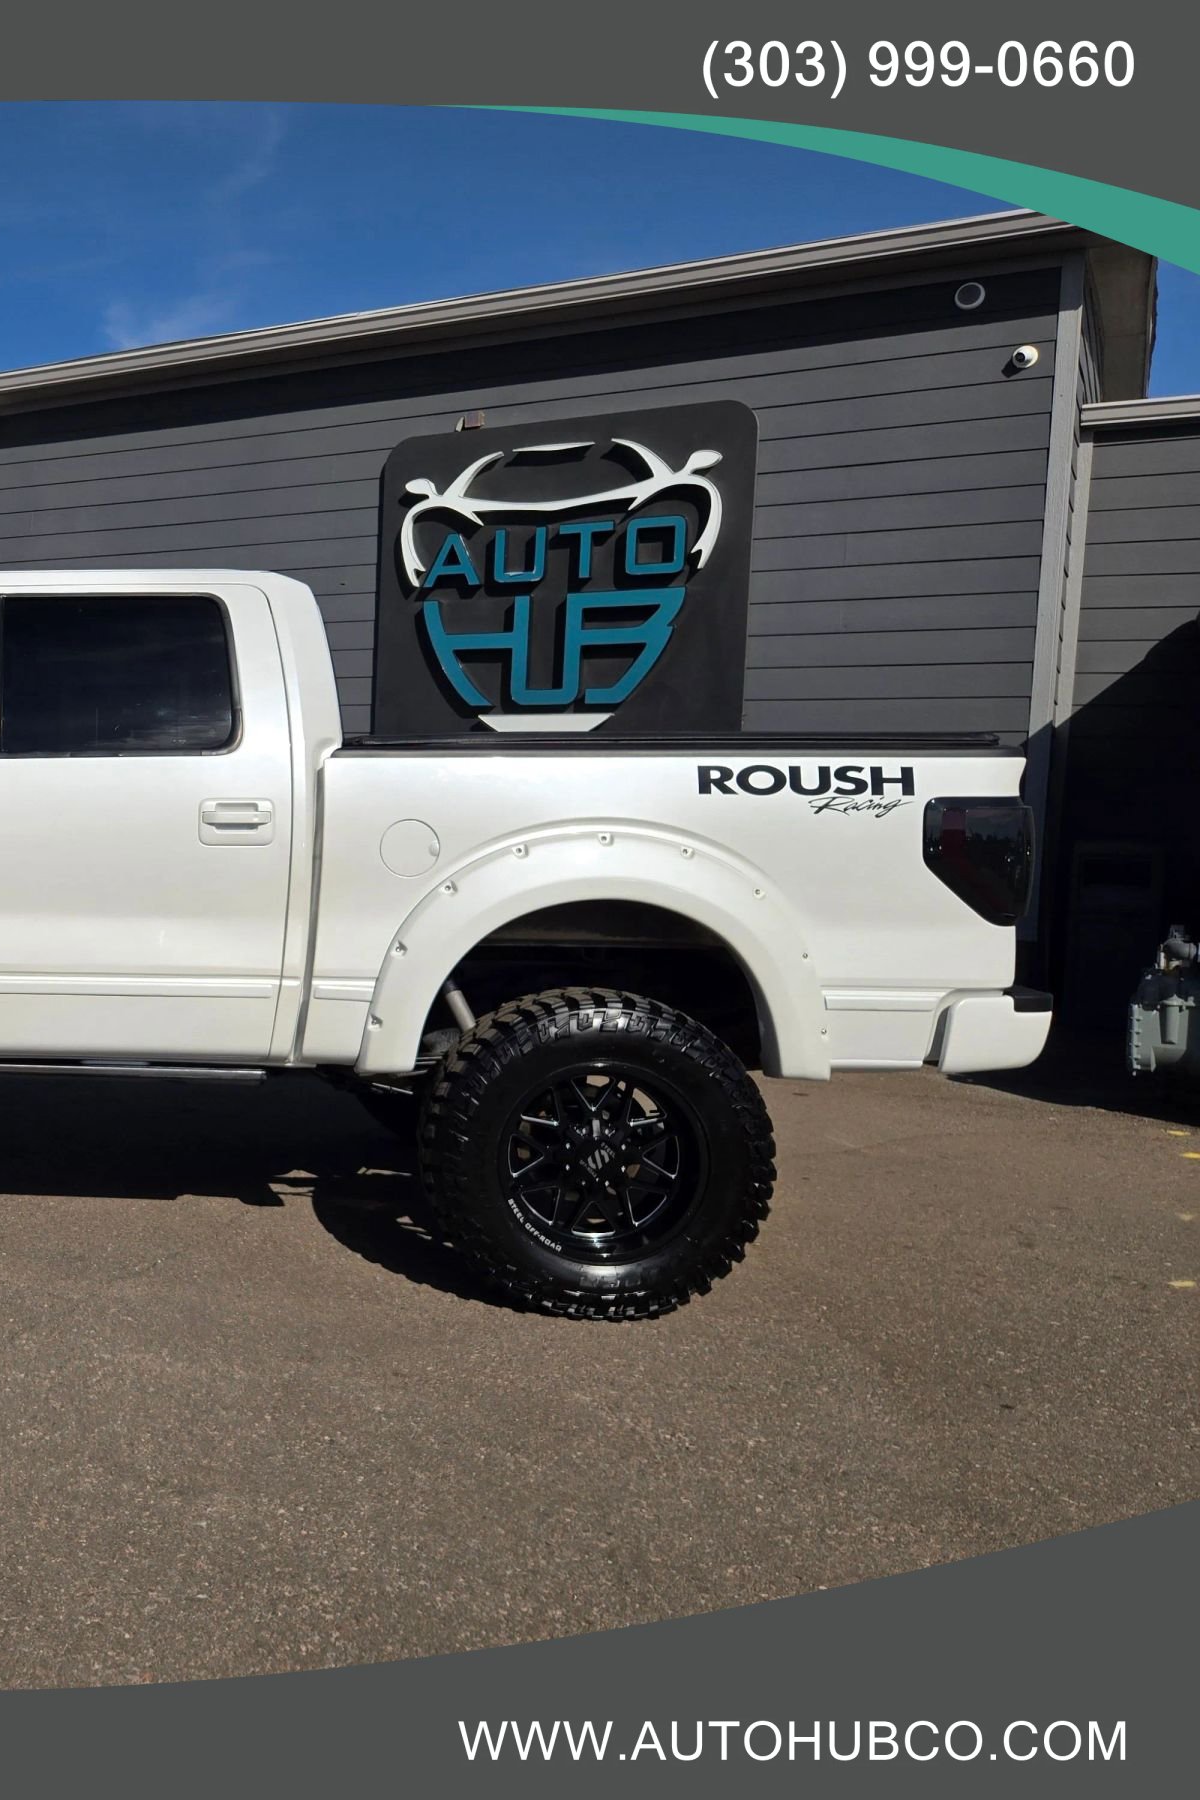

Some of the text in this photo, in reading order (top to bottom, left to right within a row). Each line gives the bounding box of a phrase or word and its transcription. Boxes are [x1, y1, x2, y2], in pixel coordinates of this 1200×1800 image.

[422, 514, 688, 589] AUTO
[422, 585, 687, 707] HUB
[697, 764, 915, 796] ROUSH
[808, 796, 914, 818] Racing
[507, 1198, 525, 1224] STEEL
